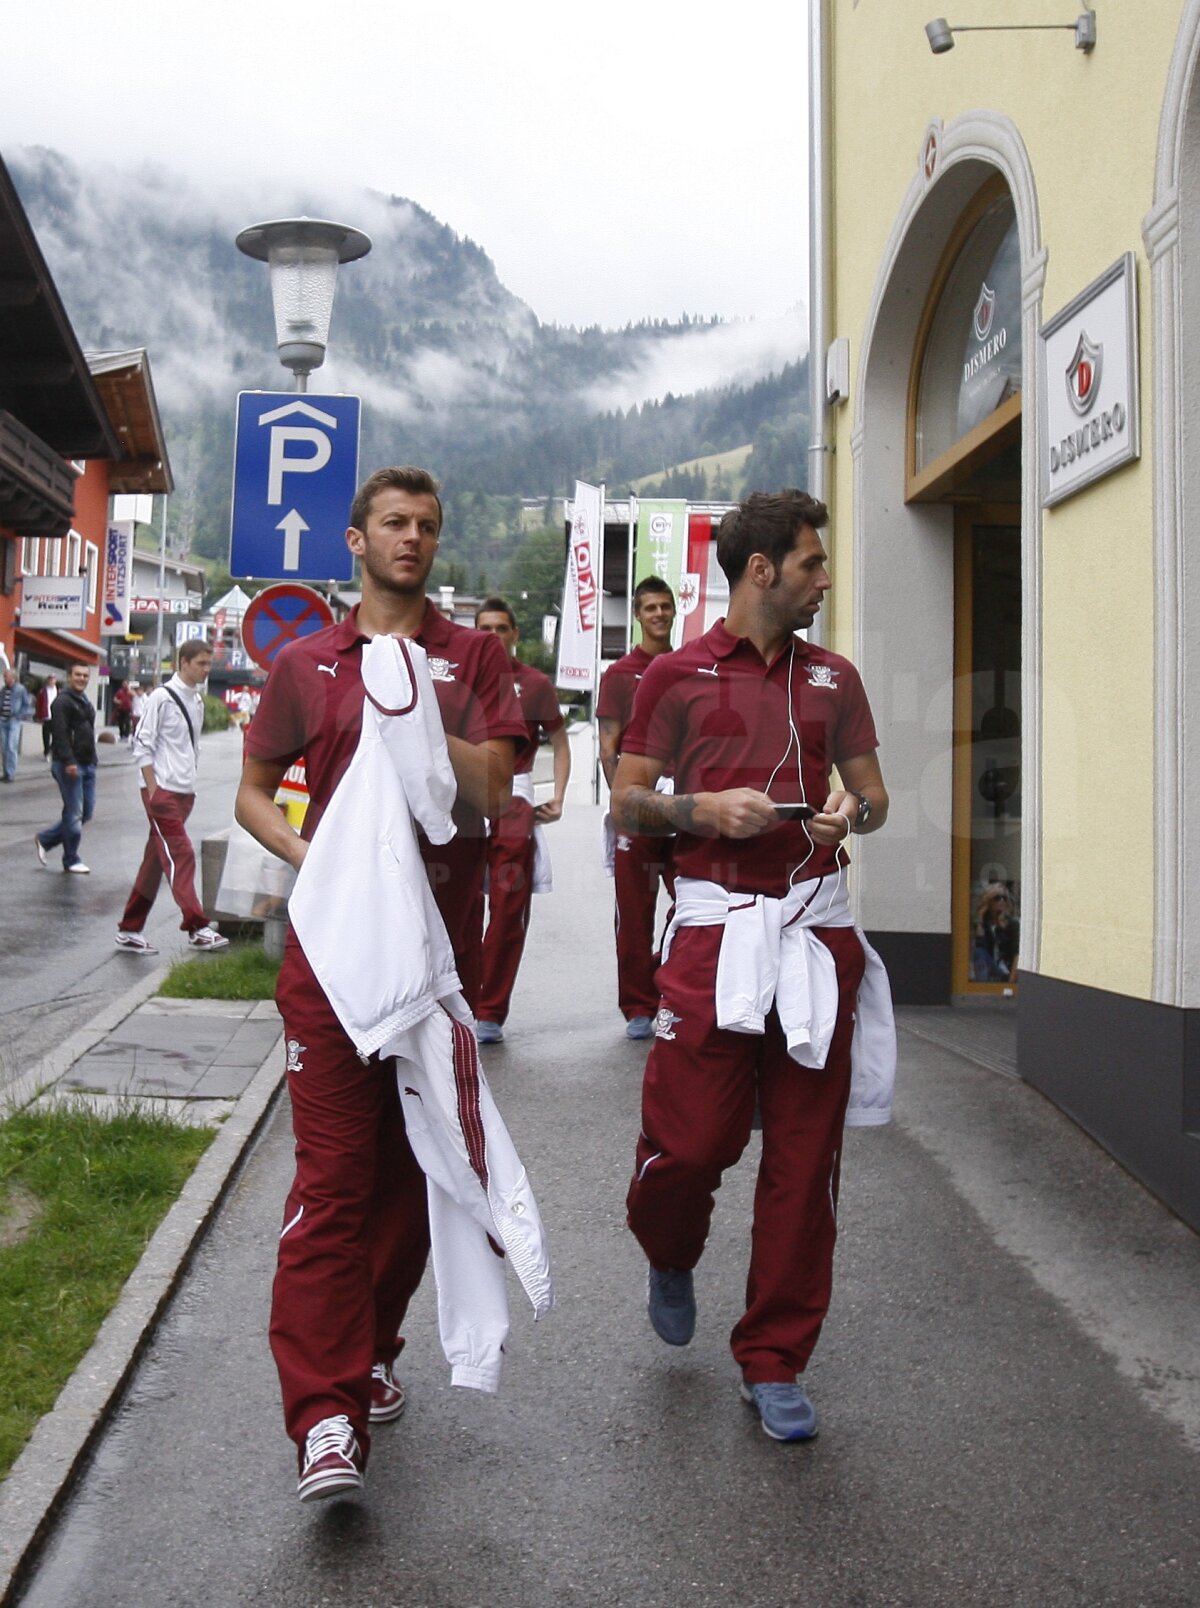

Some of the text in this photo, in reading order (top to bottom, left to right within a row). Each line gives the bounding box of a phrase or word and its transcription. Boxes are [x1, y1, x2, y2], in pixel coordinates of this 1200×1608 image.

[963, 327, 1007, 382] DISMERO
[1077, 360, 1093, 398] D
[267, 425, 332, 505] P
[1050, 402, 1126, 473] DISMERO
[106, 527, 118, 601] INTERSPORT
[117, 534, 127, 597] KITZSPORT
[32, 594, 81, 603] INTERSPORT
[38, 602, 69, 610] Rent
